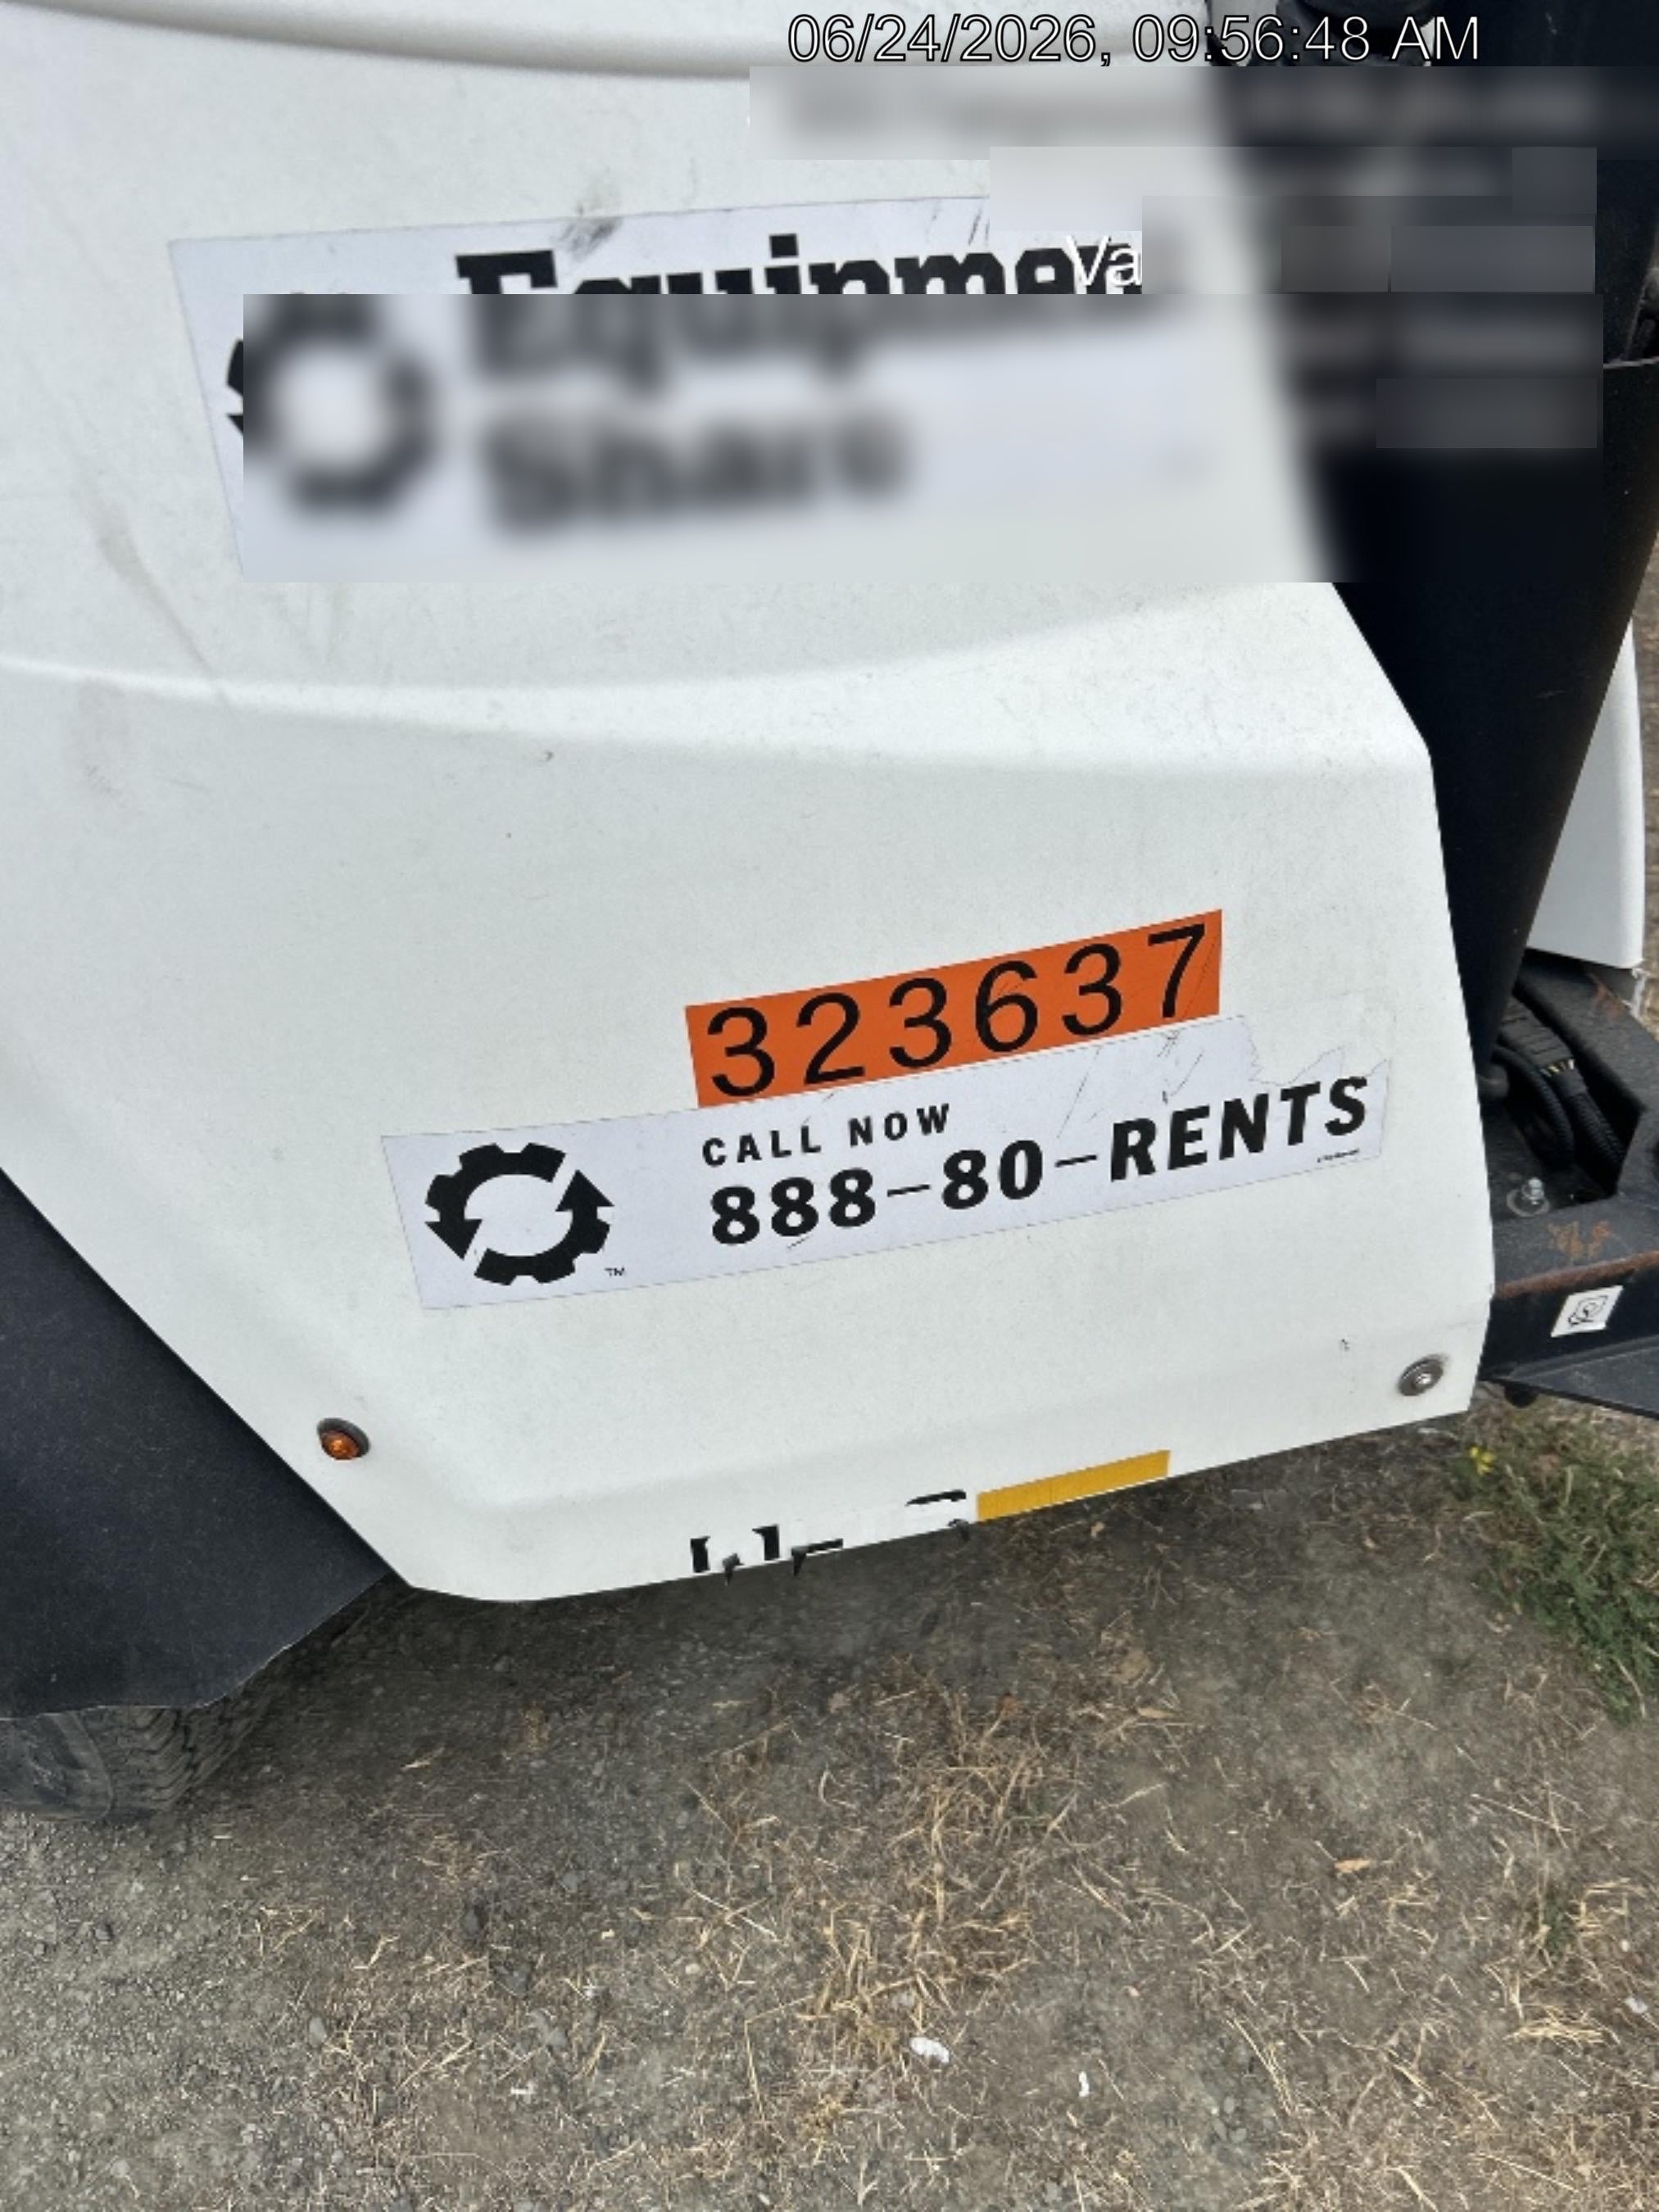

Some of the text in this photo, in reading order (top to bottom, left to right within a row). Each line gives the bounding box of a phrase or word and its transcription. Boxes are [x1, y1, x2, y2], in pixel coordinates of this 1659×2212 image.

[706, 922, 1206, 1098] 323637
[702, 1103, 950, 1168] CALL NOW
[710, 1076, 1369, 1245] 888-80-RENTS
